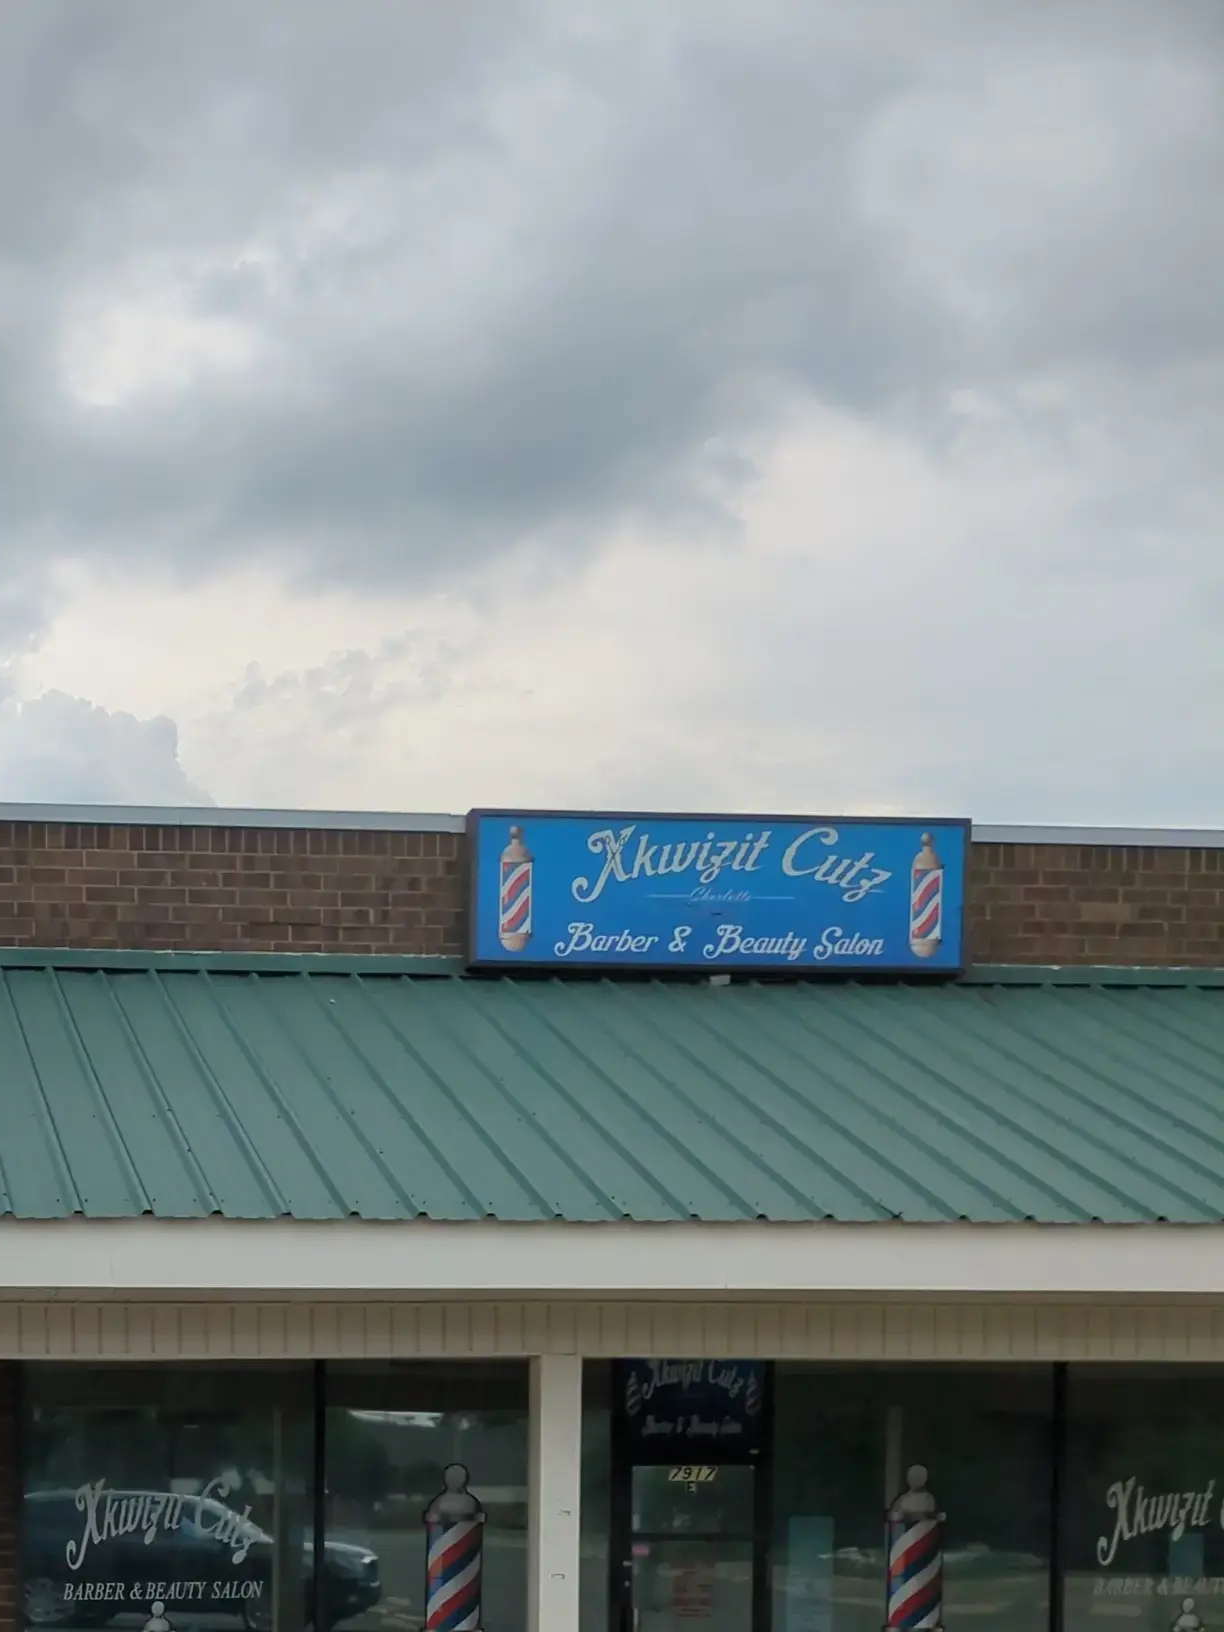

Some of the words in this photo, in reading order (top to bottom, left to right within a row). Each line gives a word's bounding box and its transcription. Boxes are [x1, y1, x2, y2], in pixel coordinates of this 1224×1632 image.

[571, 824, 772, 903] Xkwizit
[781, 827, 893, 902] Cutz
[554, 922, 659, 957] Barber
[668, 926, 693, 953] &
[703, 923, 807, 961] Beauty
[813, 927, 883, 960] Salon
[1097, 1476, 1216, 1566] Xkwizit
[63, 1582, 125, 1601] BARBER
[130, 1583, 144, 1600] &
[145, 1581, 207, 1600] BEAUTY
[211, 1580, 264, 1600] SALON
